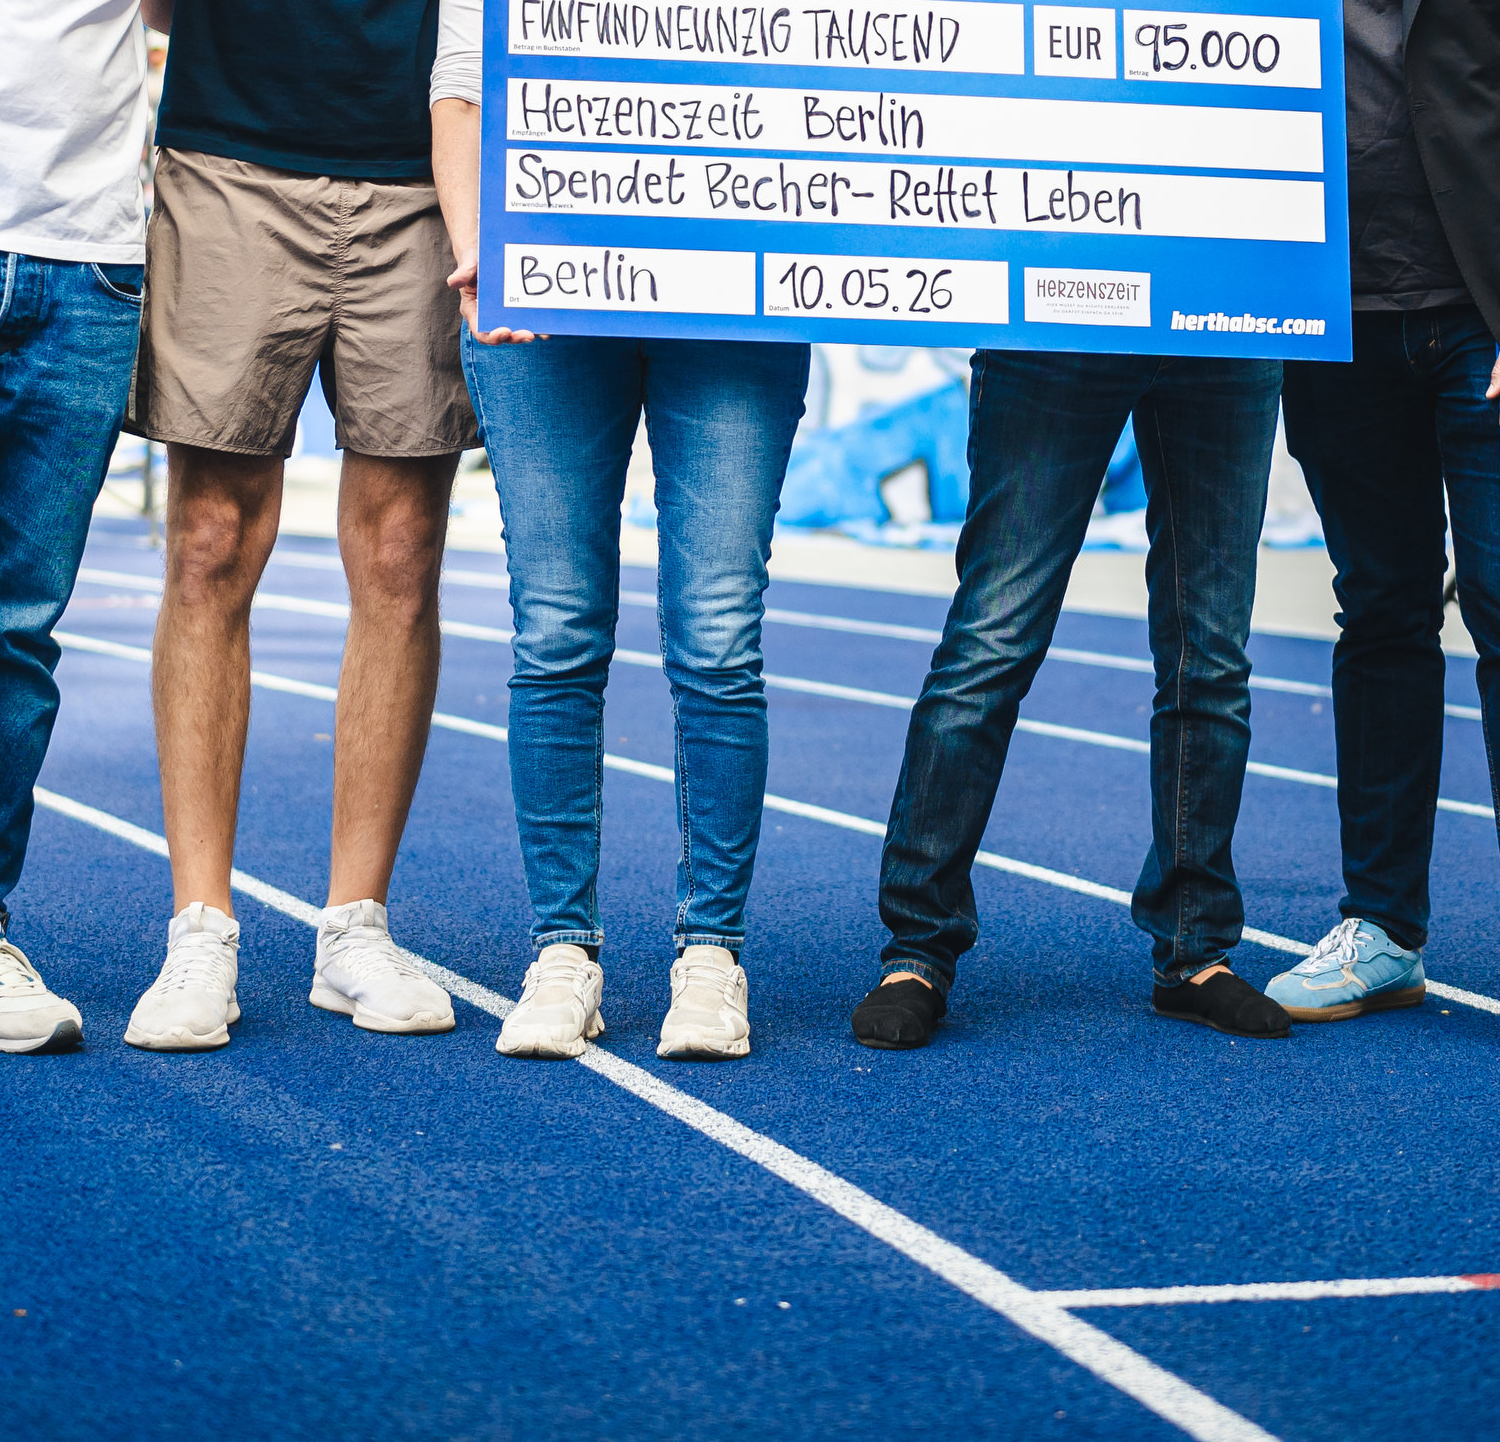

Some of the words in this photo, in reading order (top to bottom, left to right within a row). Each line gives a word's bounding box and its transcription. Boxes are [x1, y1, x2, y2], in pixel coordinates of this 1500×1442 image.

[513, 44, 534, 52] Betrag
[802, 8, 960, 64] TAUSEND
[1049, 25, 1102, 60] EUR
[1135, 23, 1280, 73] 95.000
[512, 129, 546, 137] Empfänger
[522, 82, 763, 140] Herzenszeit
[804, 92, 924, 148] Berlin
[511, 201, 574, 209] Verwendunszweck
[516, 153, 685, 208] Spendet
[890, 167, 998, 224] Rettet
[1023, 170, 1142, 230] Leben
[521, 250, 658, 302] Berlin
[779, 262, 953, 313] 10.05.26
[1170, 311, 1326, 335] herthabsc.com
